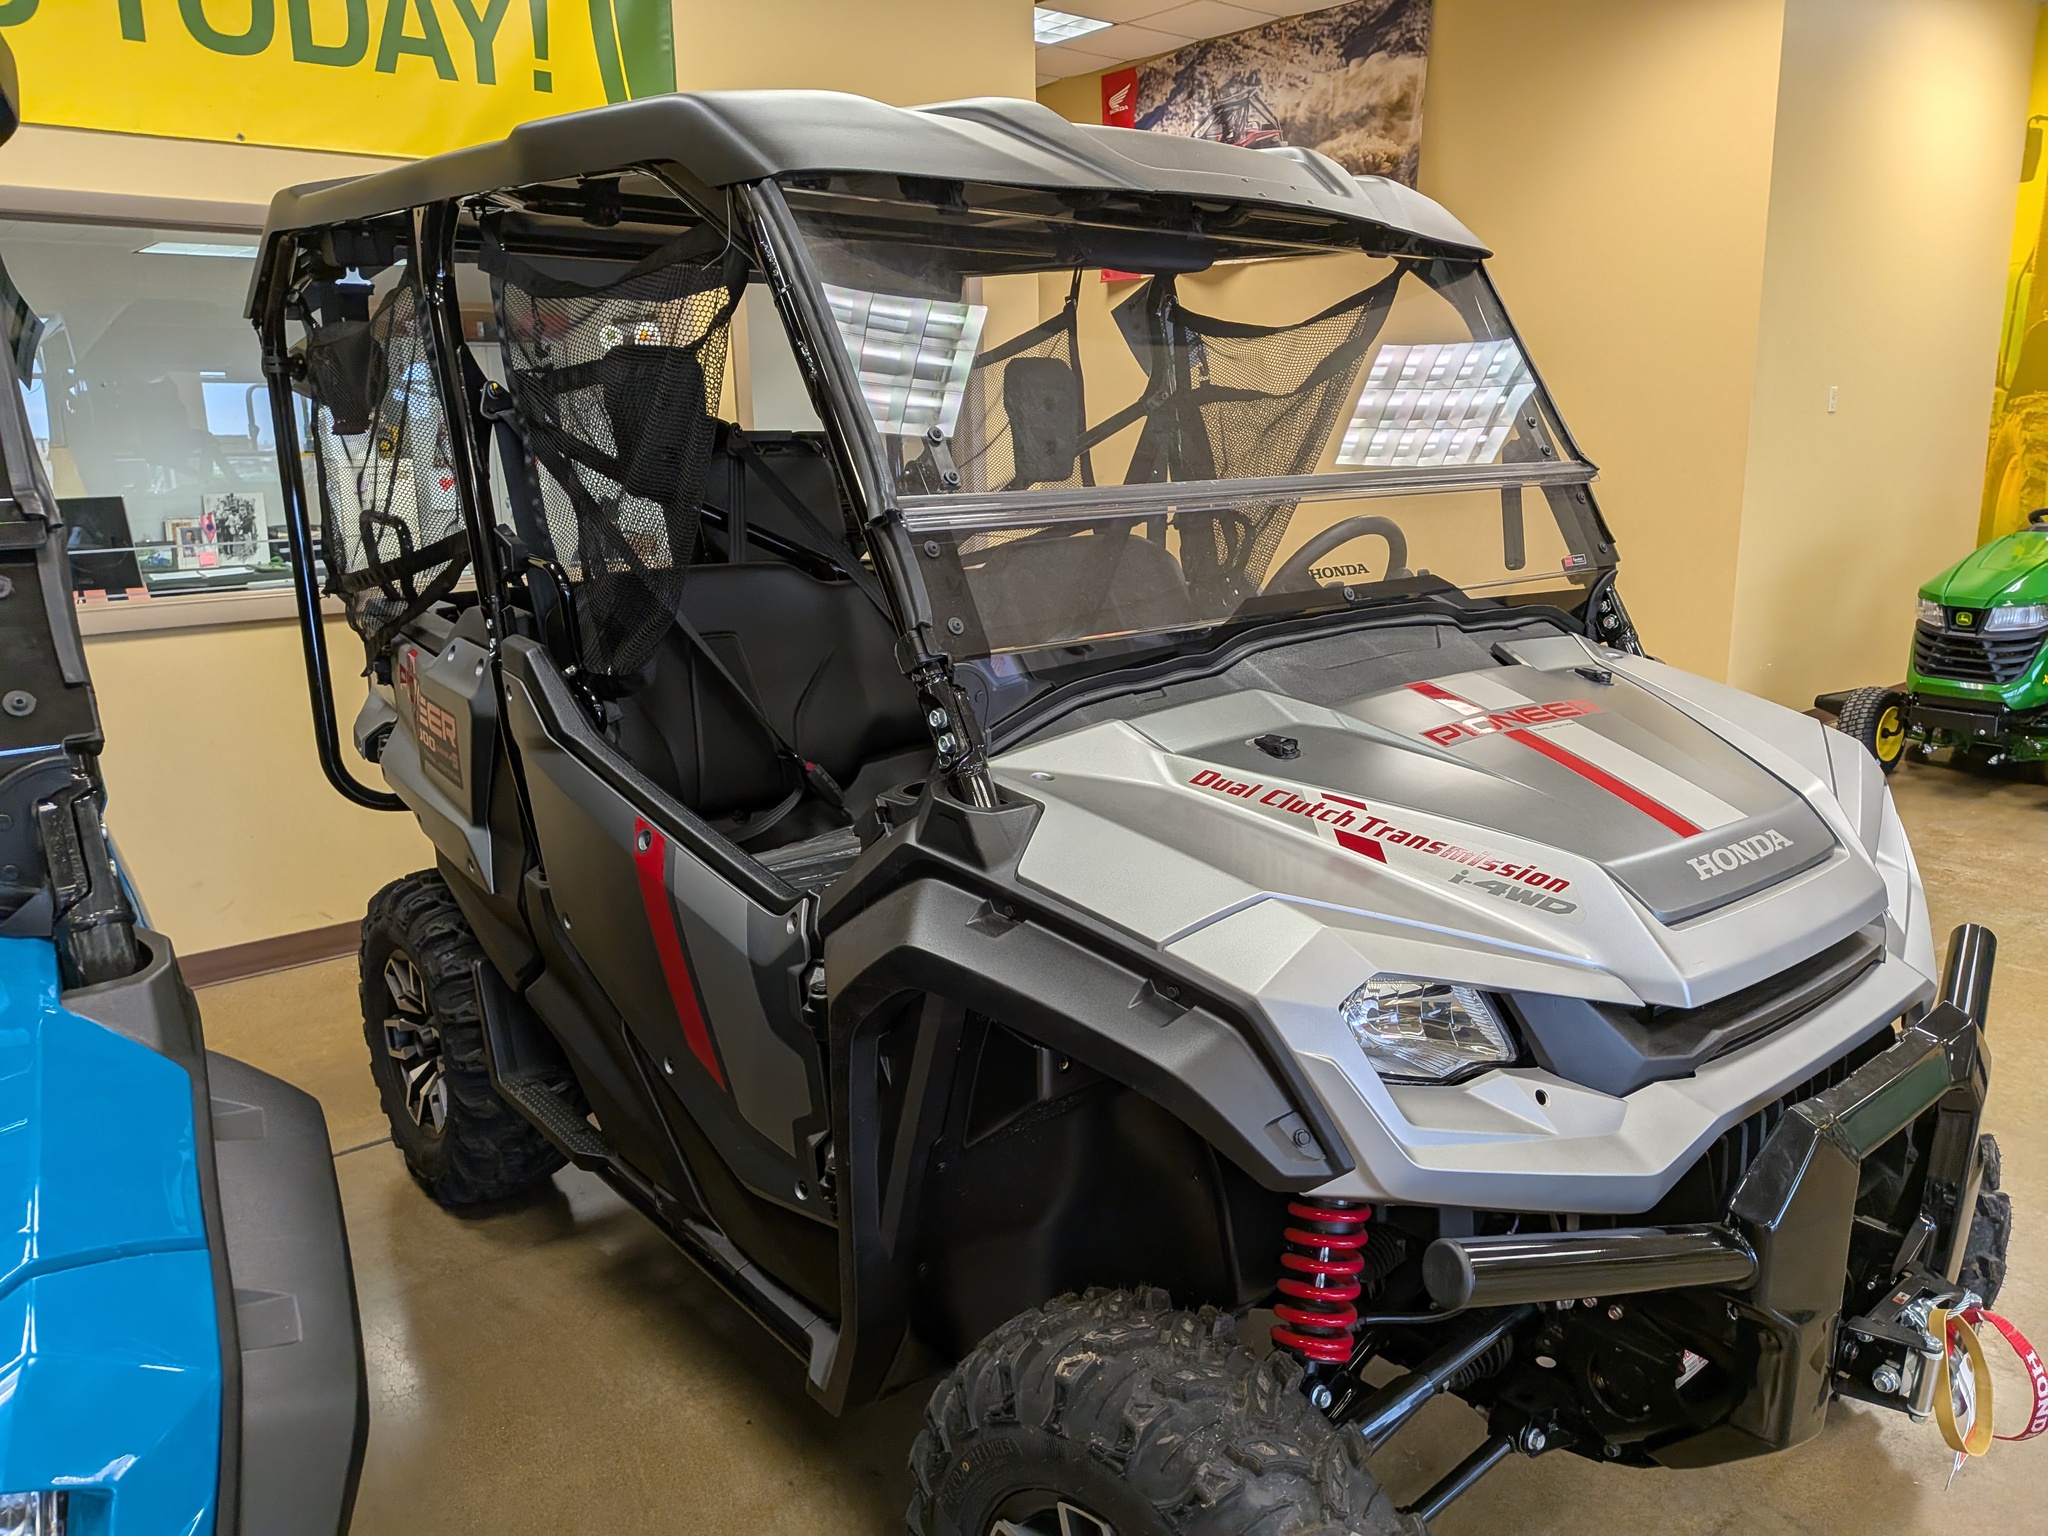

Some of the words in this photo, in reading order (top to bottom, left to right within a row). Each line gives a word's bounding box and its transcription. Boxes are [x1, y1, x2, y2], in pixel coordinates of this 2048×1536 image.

[1308, 563, 1370, 579] HONDA
[1419, 699, 1605, 747] PIONEER
[1188, 769, 1264, 799] Dual
[1259, 789, 1356, 827] Clutch
[1357, 815, 1572, 894] Transmission
[1685, 829, 1794, 881] HONDA
[1448, 869, 1578, 915] i-4WD
